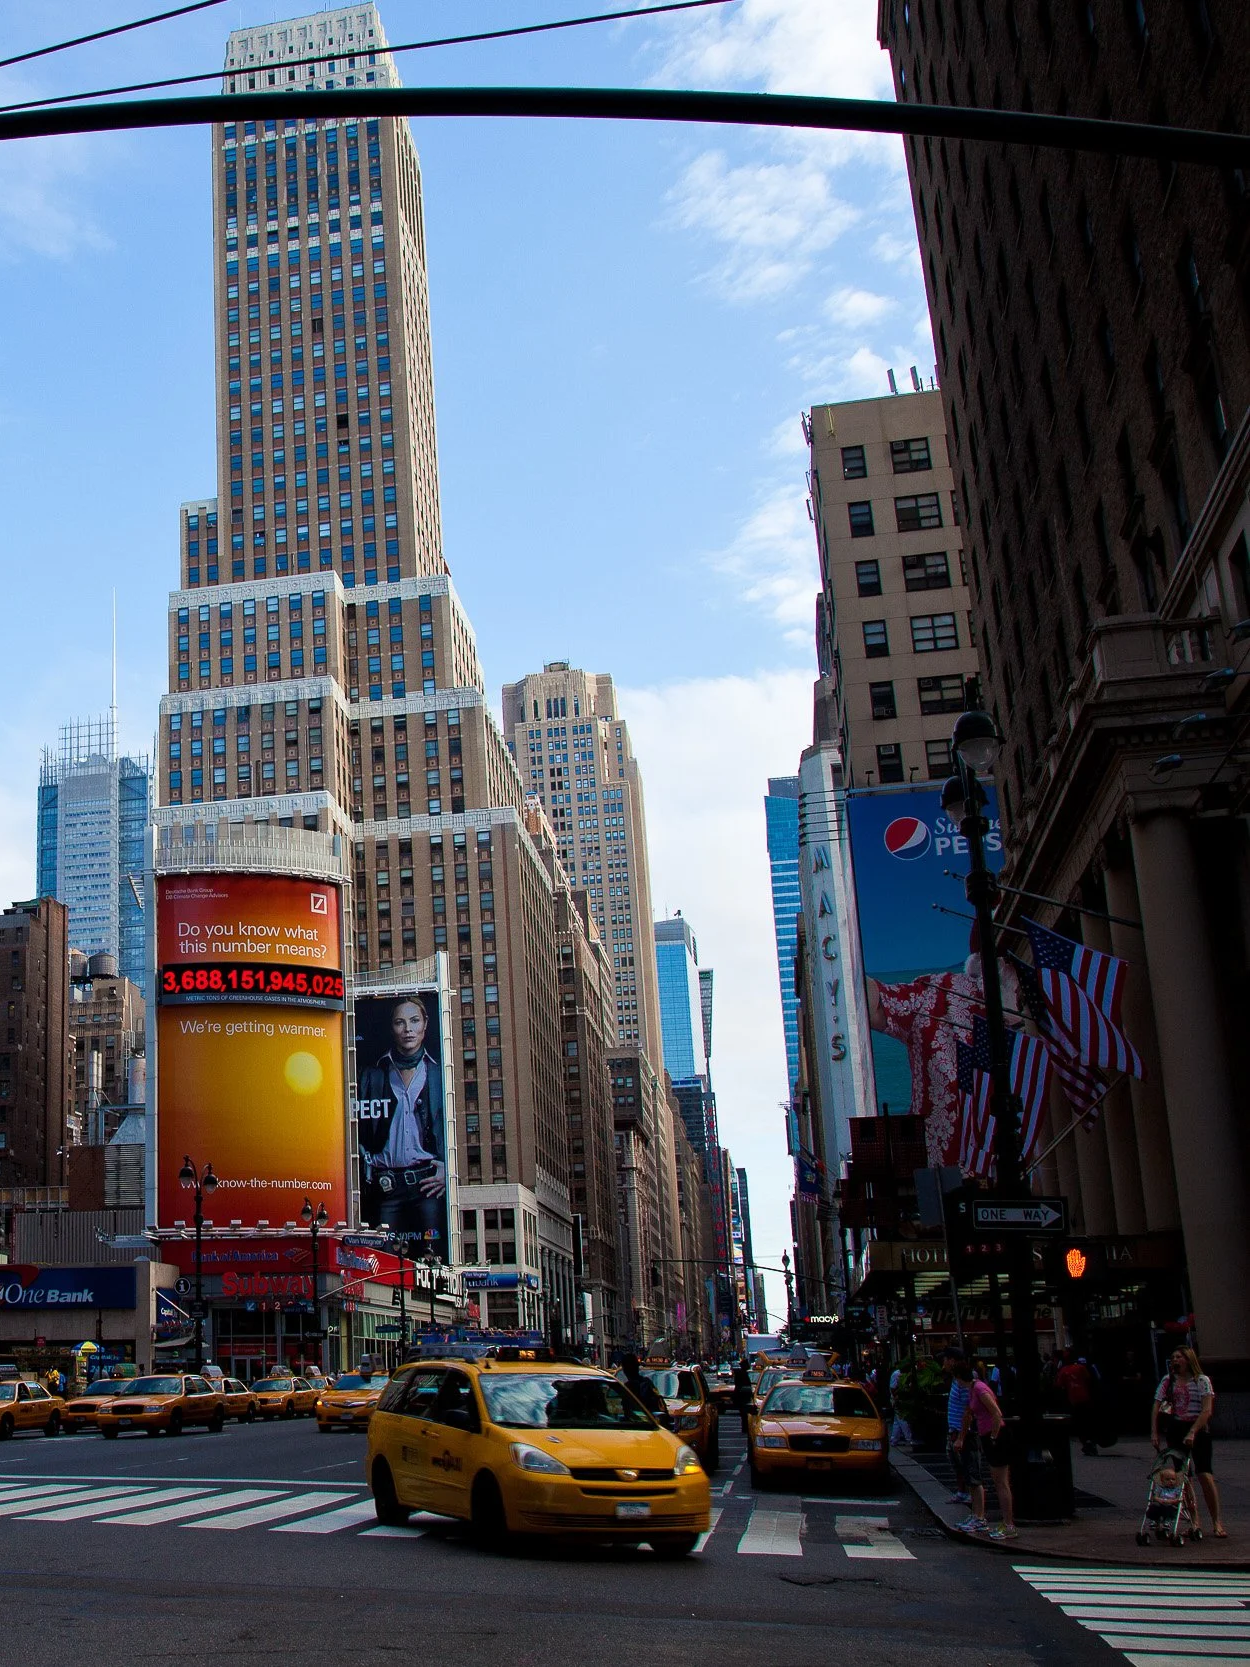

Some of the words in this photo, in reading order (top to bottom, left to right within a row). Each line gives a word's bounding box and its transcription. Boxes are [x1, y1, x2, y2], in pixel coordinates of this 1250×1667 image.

[178, 923, 200, 937] Do
[205, 923, 233, 938] you
[239, 922, 280, 937] know
[285, 925, 318, 941] what
[179, 940, 207, 954] this
[212, 939, 271, 953] number
[276, 942, 327, 958] means?
[163, 969, 344, 997] 3,688,151,945,025
[297, 998, 326, 1006] ATMOSPHERE
[180, 1019, 221, 1034] We're
[226, 1021, 274, 1036] getting
[279, 1026, 327, 1038] warmer.
[981, 1209, 1006, 1220] ONE
[1023, 1209, 1050, 1220] WAY
[348, 1237, 359, 1245] Van
[360, 1237, 382, 1247] Wagner
[5, 1283, 44, 1303] One
[46, 1289, 94, 1303] Bank
[222, 1272, 316, 1299] Subway
[810, 1313, 839, 1325] macy's
